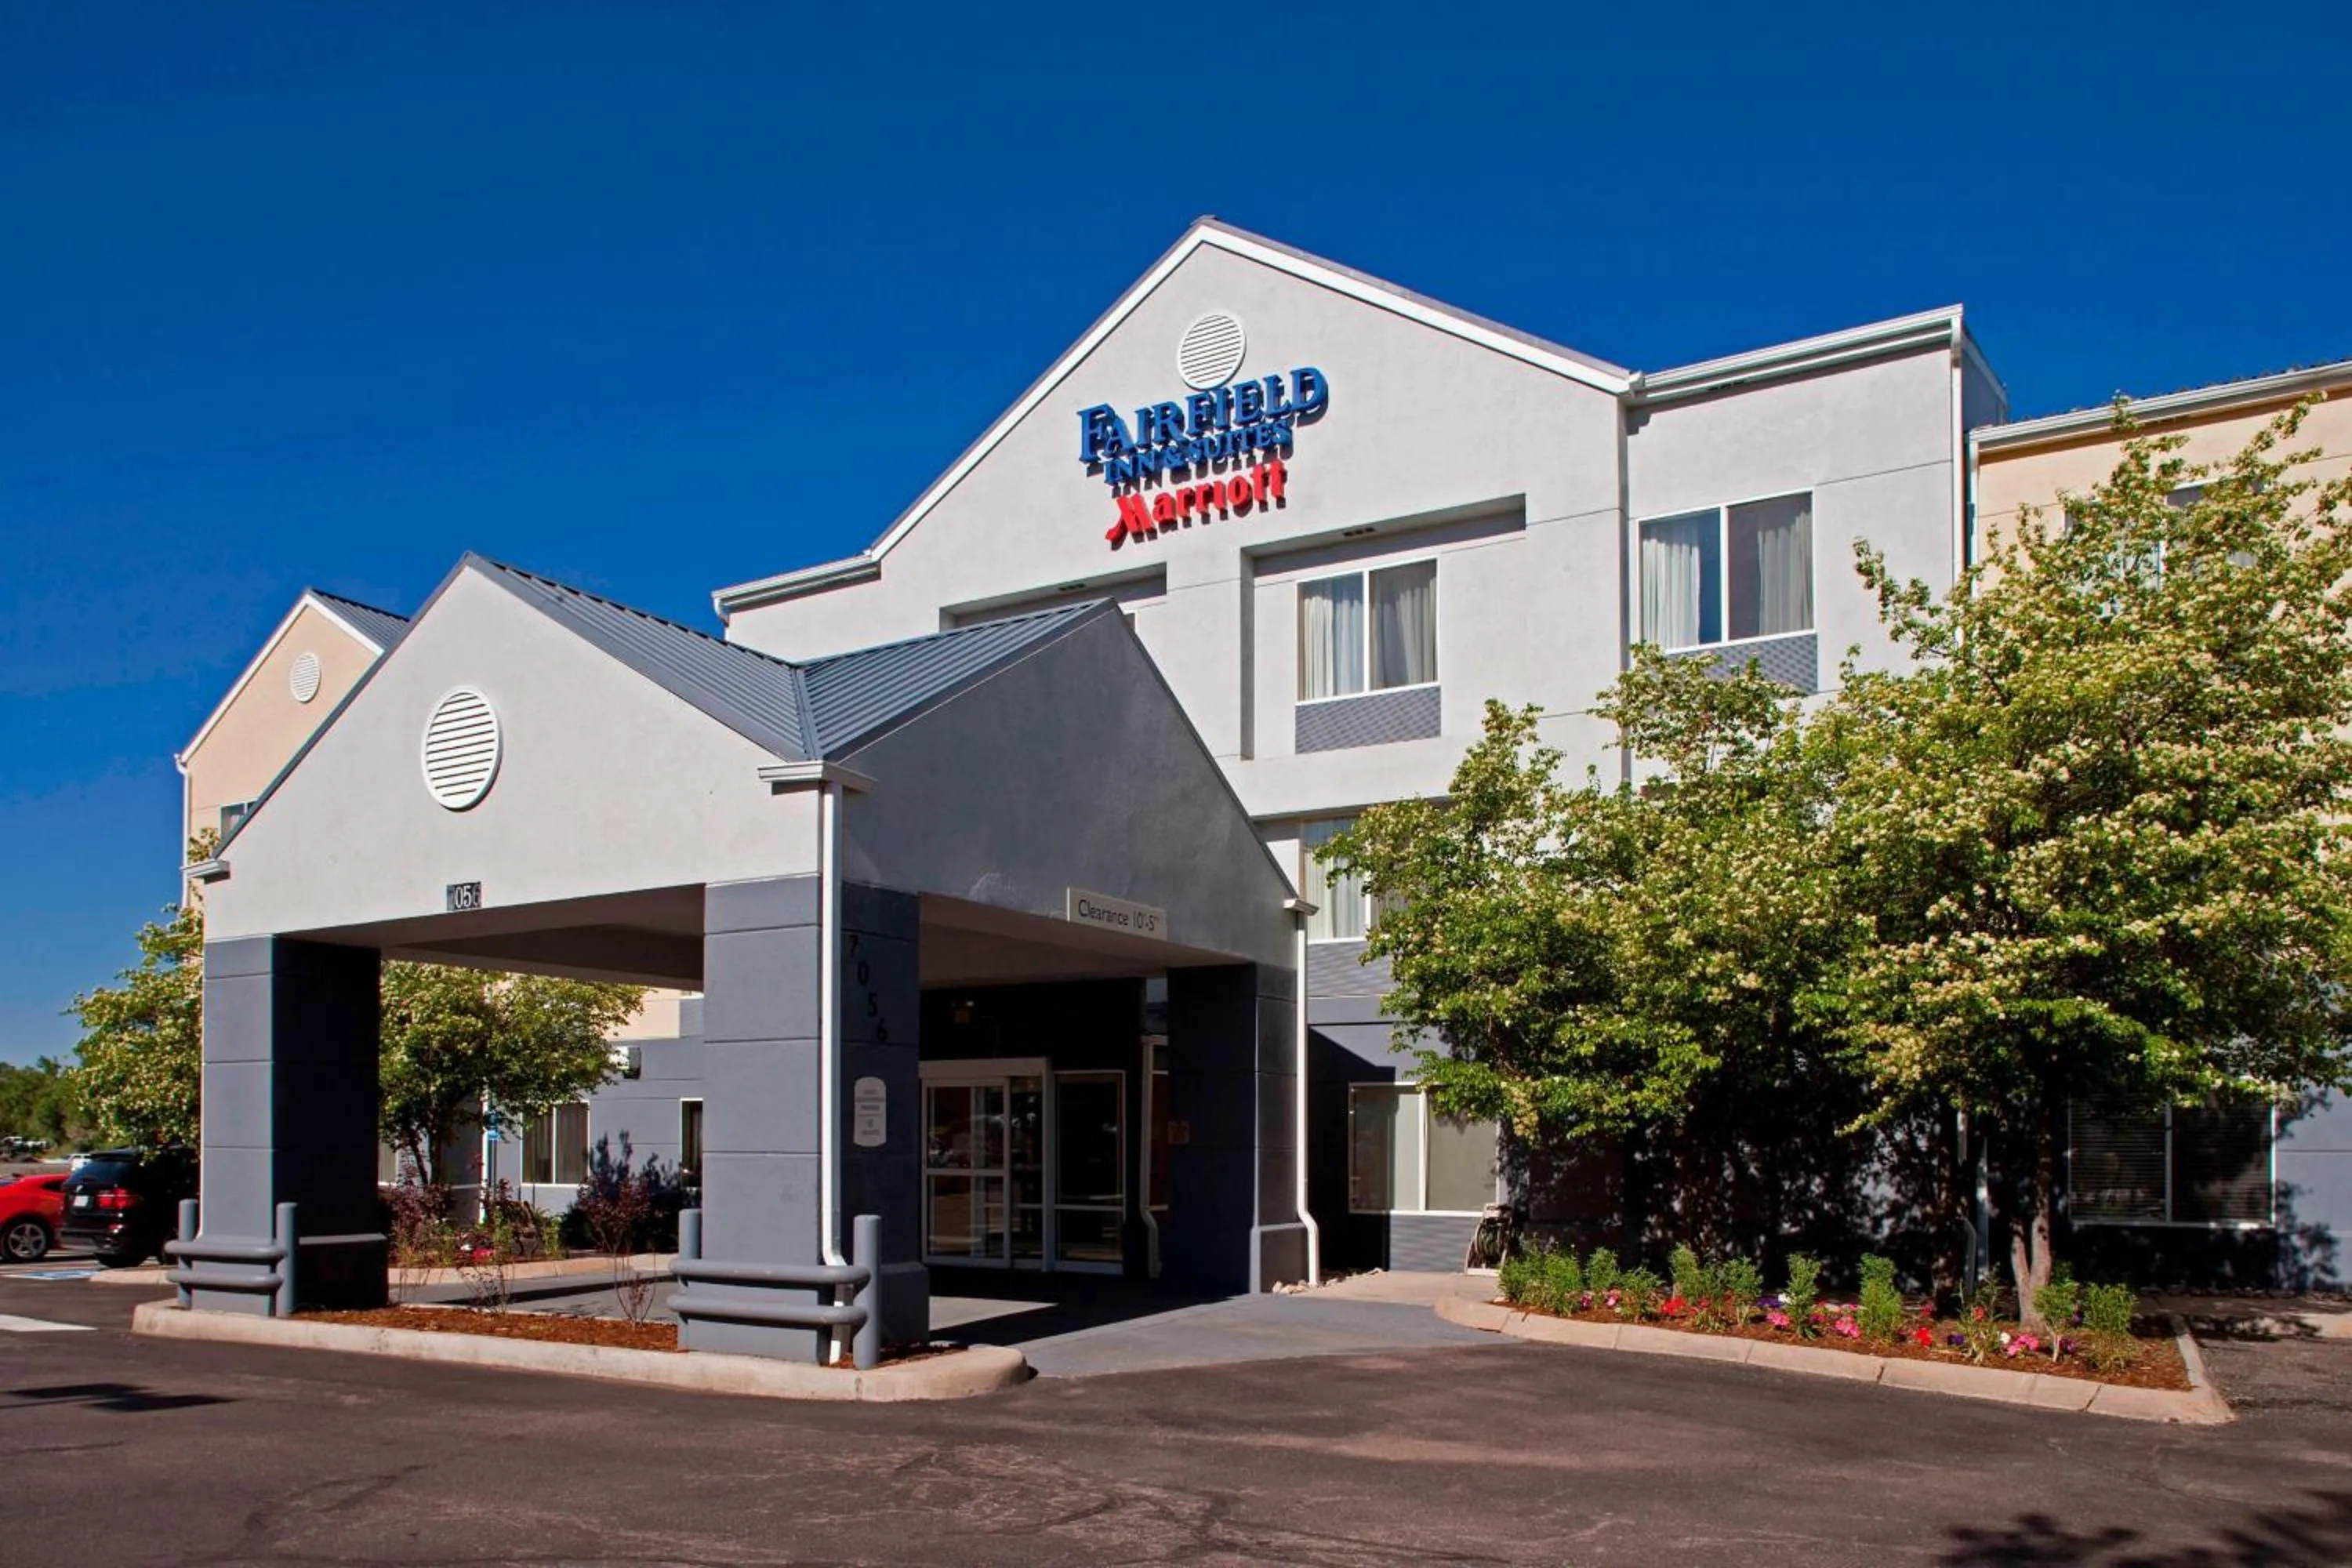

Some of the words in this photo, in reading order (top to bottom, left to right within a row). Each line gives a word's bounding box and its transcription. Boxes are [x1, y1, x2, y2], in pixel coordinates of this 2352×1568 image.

[1077, 366, 1329, 462] FAIRFIELD
[1104, 449, 1159, 485] INN
[1162, 444, 1187, 470] &
[1187, 419, 1291, 464] SUITES
[1105, 458, 1286, 542] Marriott
[1078, 898, 1129, 926] Clearance
[849, 934, 888, 1044] 7056
